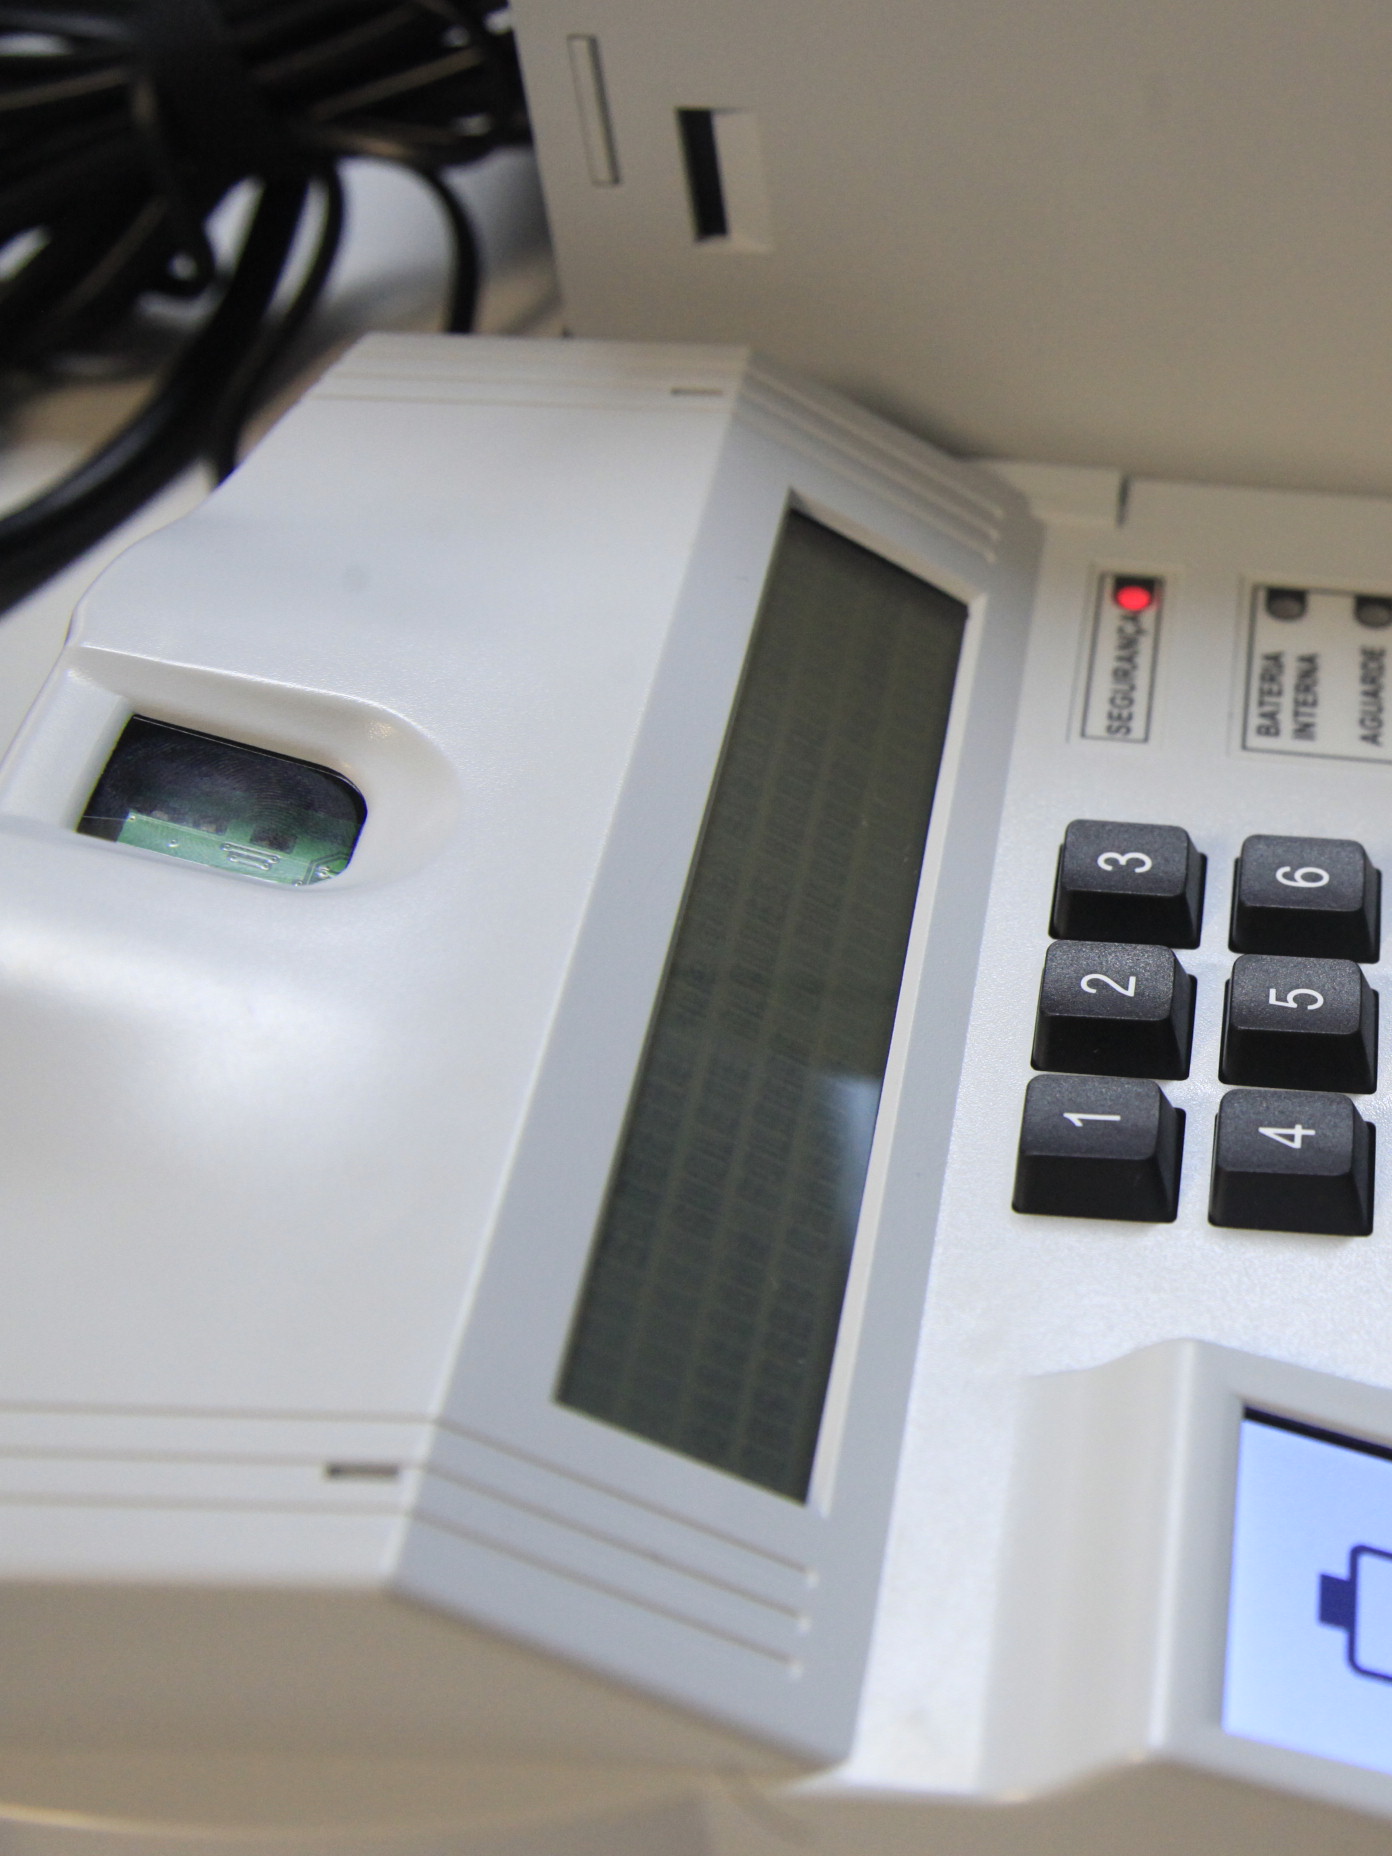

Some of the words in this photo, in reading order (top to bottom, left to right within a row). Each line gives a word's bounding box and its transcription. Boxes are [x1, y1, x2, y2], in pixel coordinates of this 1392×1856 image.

[1256, 652, 1283, 738] BATERIA
[1292, 652, 1319, 741] INTERNA
[1359, 645, 1387, 747] AGUARDE
[1096, 851, 1153, 874] 3
[1275, 865, 1330, 888] 6
[1080, 972, 1137, 998] 2
[1268, 987, 1325, 1010] 5
[1062, 1112, 1121, 1128] 1
[1258, 1124, 1316, 1149] 4
